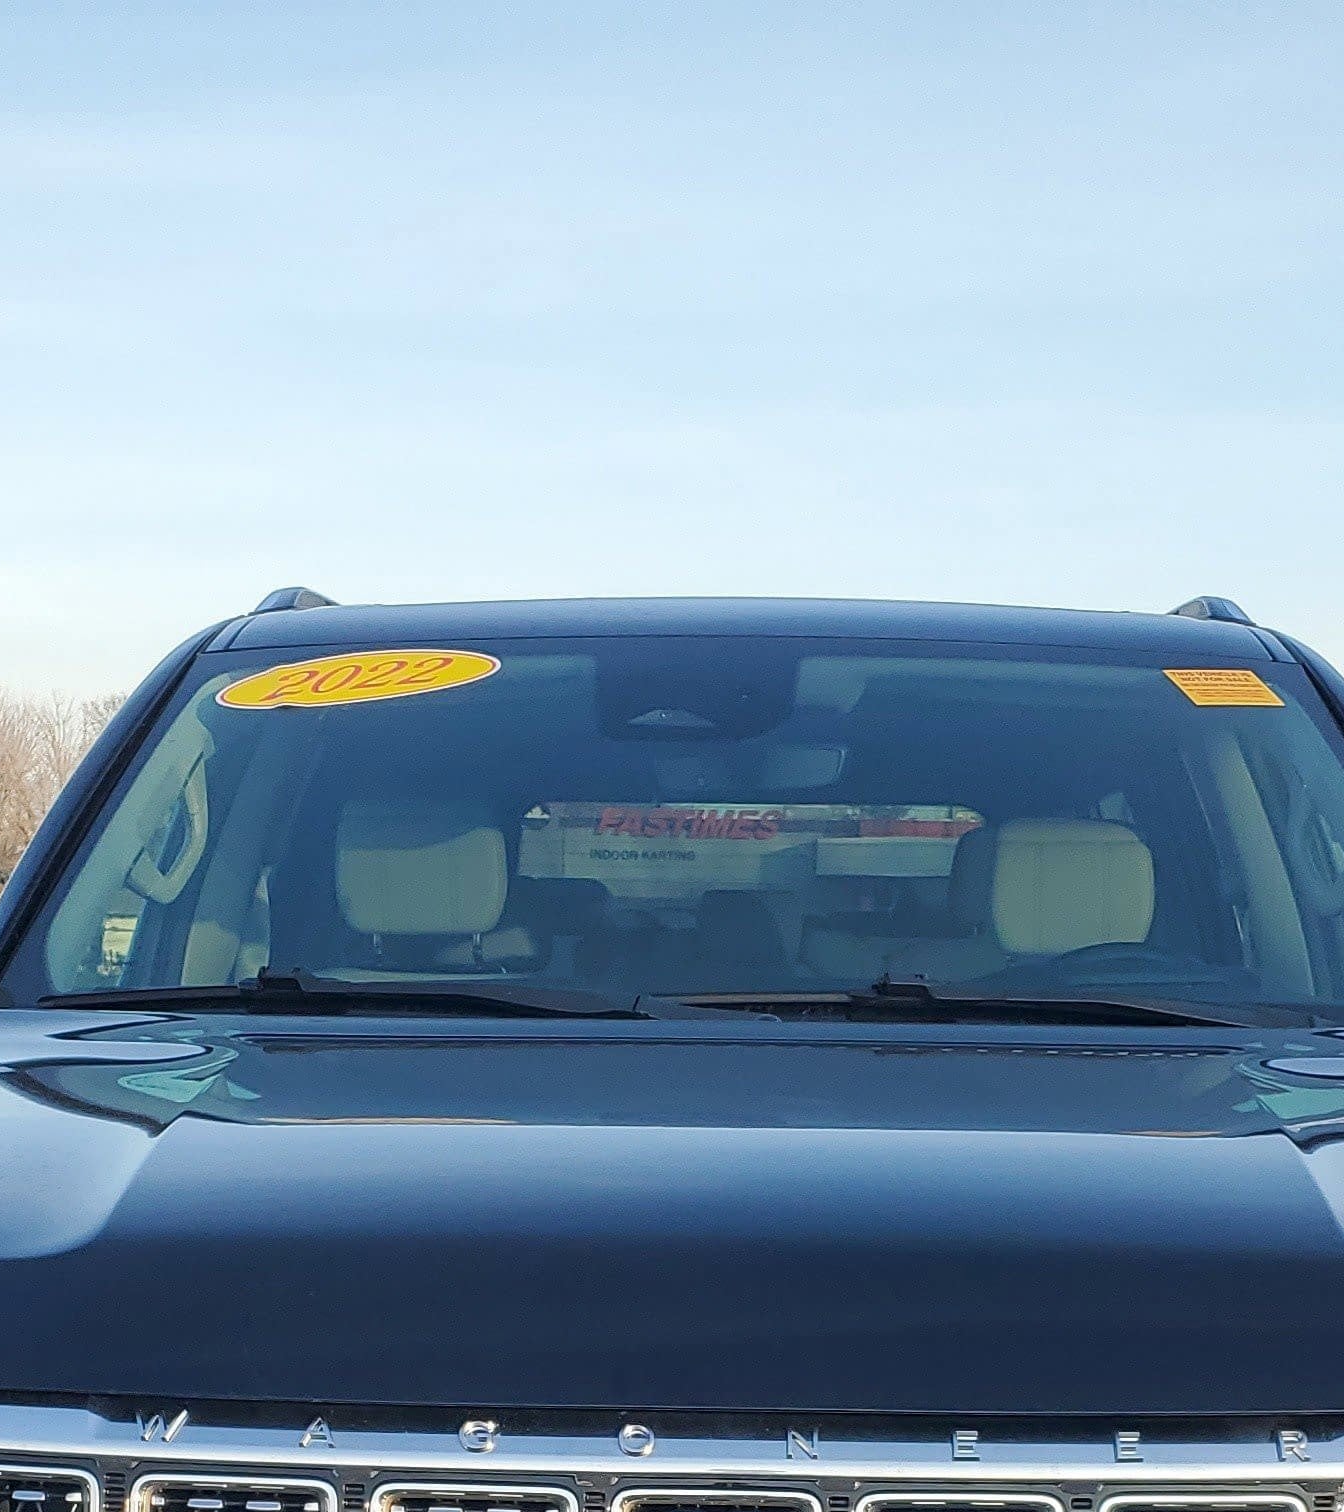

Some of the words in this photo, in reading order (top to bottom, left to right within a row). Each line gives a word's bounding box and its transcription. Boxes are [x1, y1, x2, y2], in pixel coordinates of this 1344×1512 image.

[258, 657, 454, 702] 2022
[596, 805, 785, 840] FASTIMES
[589, 849, 638, 861] INDOOR
[133, 1408, 1311, 1463] WAGONEER
